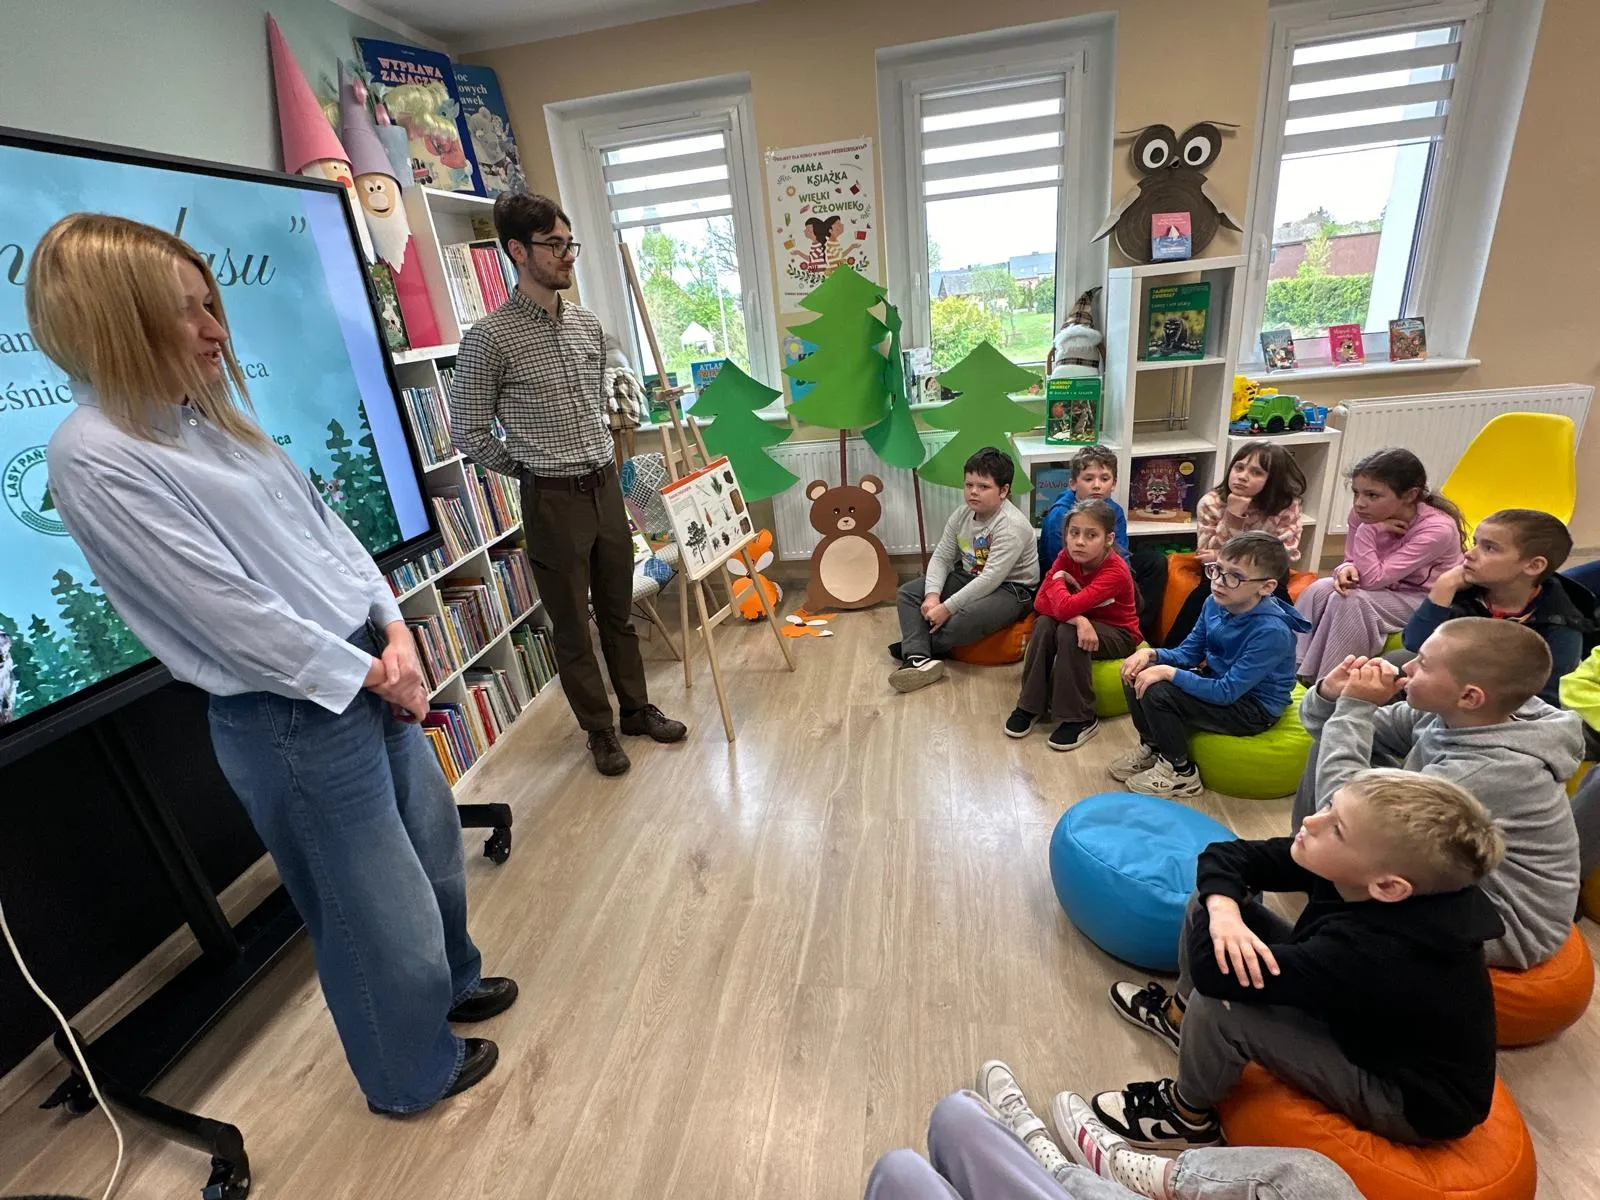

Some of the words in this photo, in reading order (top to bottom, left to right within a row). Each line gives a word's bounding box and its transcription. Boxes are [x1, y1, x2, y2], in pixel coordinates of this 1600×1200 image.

[377, 57, 443, 78] WYPRAWA
[791, 162, 823, 173] MAŁA
[807, 170, 848, 186] KSIĄŻKA
[798, 191, 830, 204] WIELKI
[812, 201, 864, 214] CZŁOWIEK
[7, 466, 22, 498] LASY
